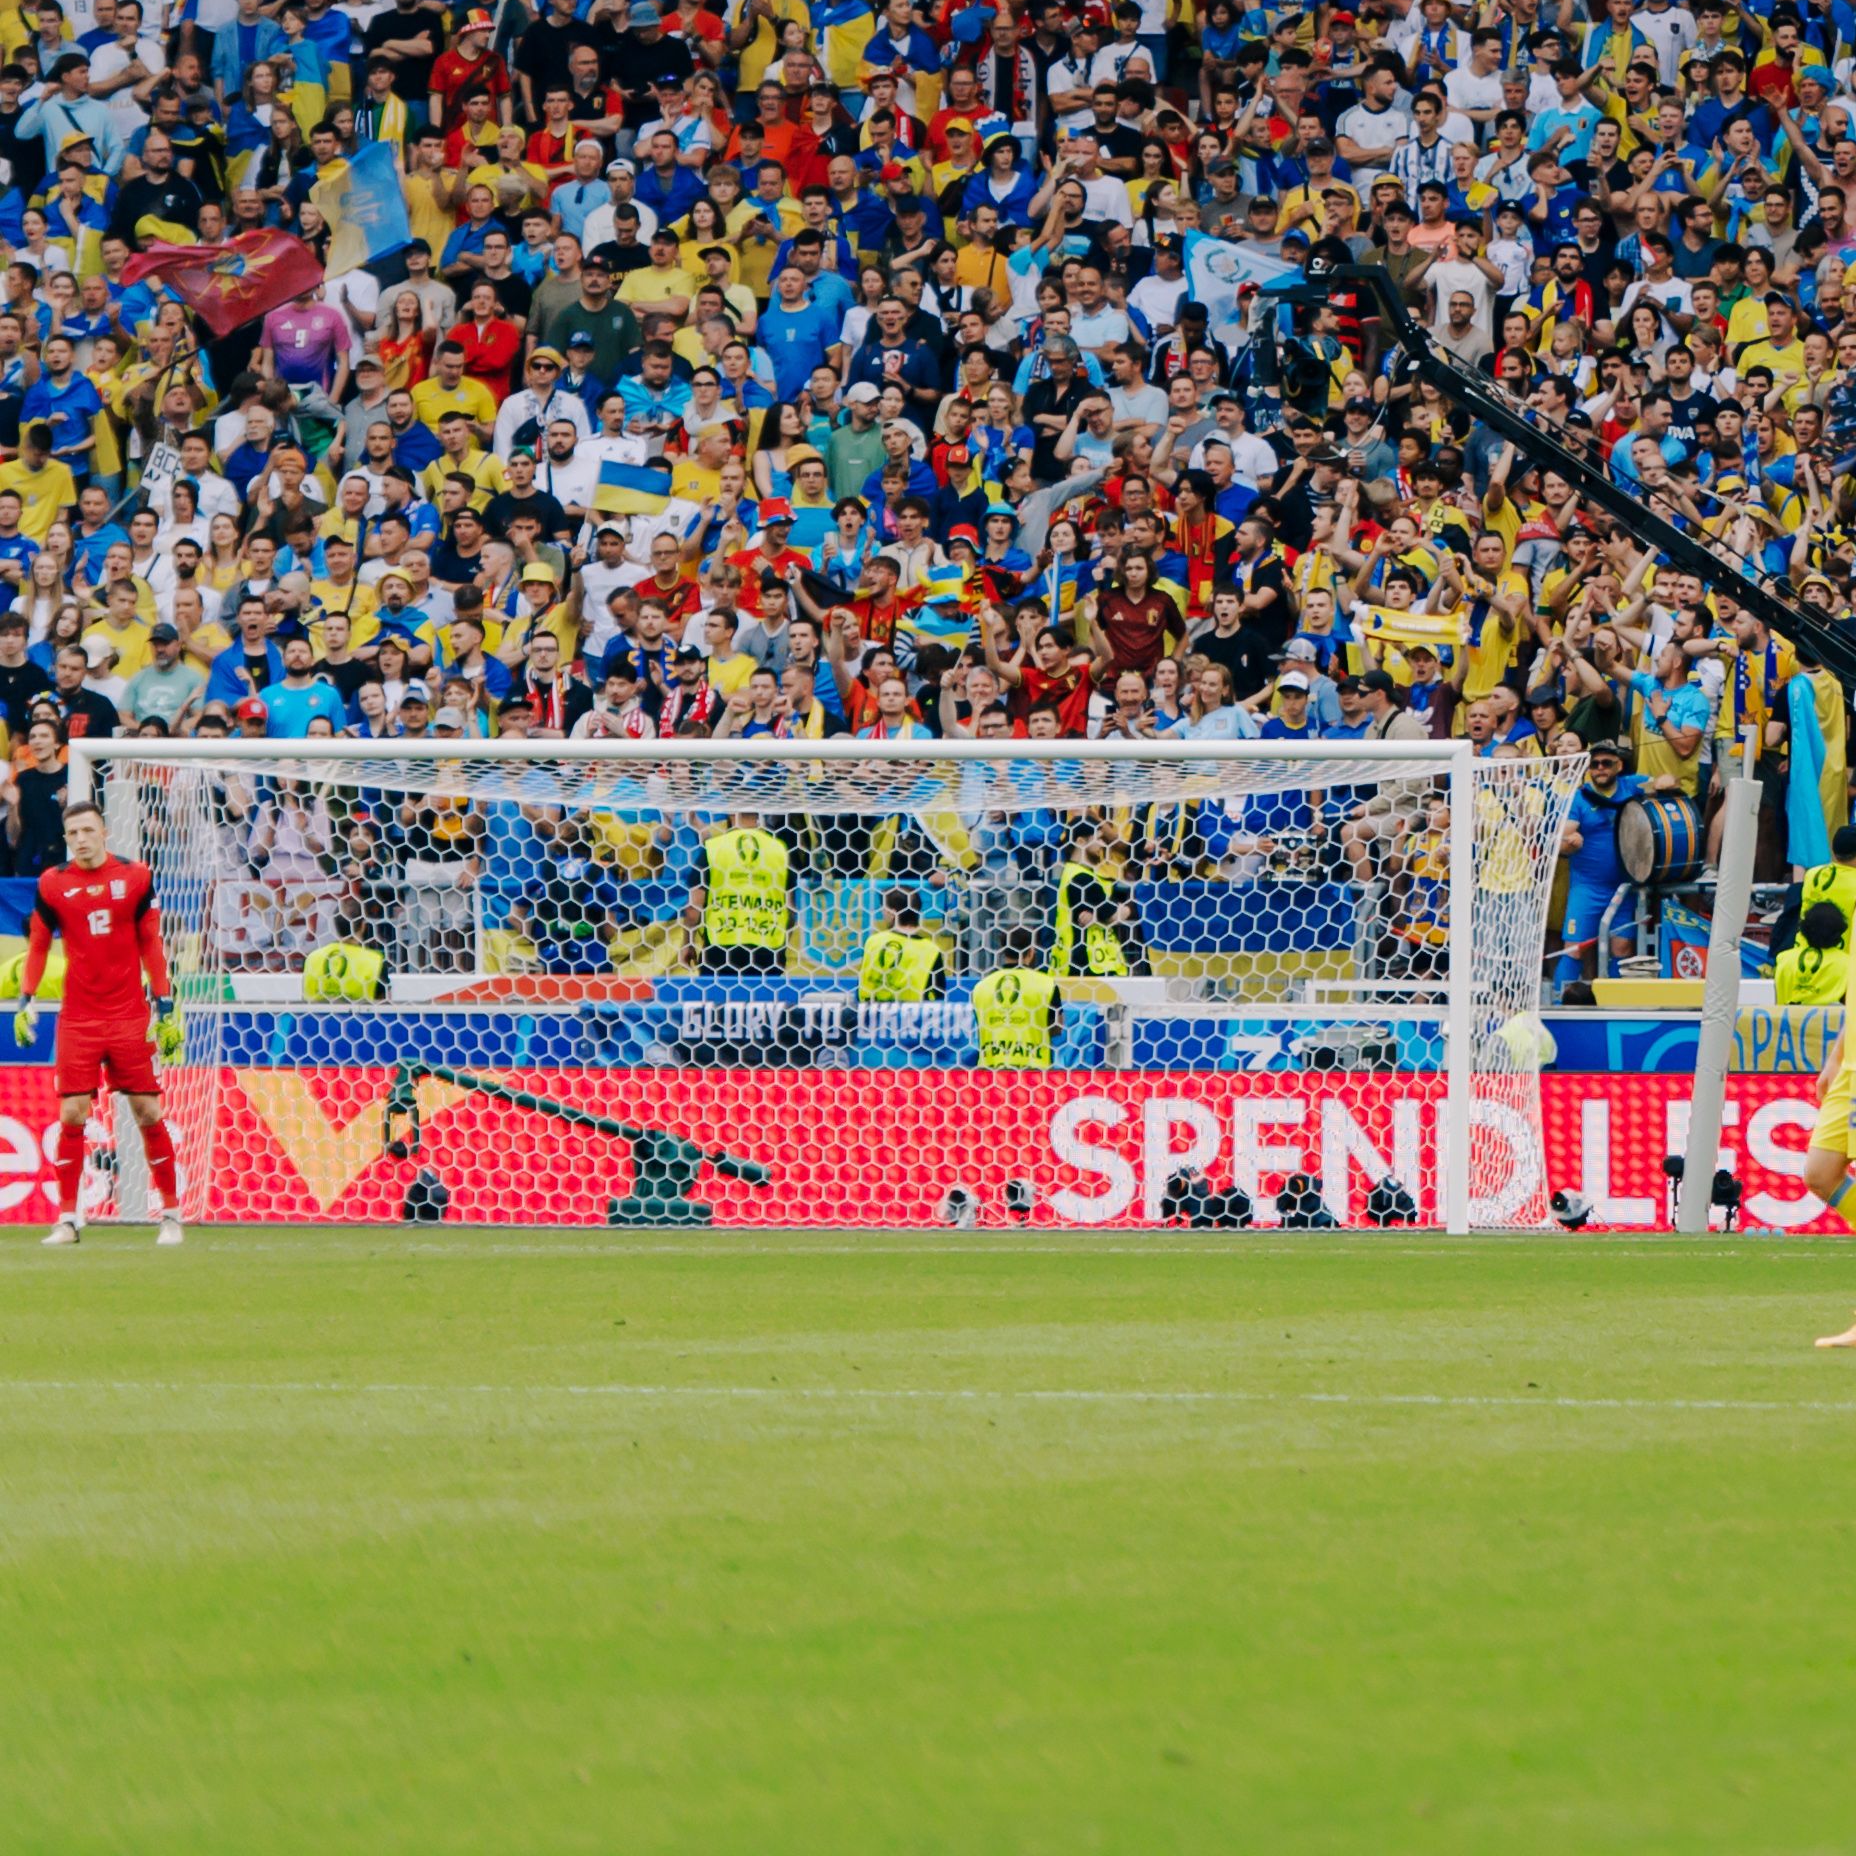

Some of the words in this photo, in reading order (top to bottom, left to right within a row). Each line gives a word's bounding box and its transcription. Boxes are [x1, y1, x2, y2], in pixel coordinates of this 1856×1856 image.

[87, 909, 111, 936] 12
[682, 1001, 787, 1040] GLORY
[800, 1001, 844, 1040] TO
